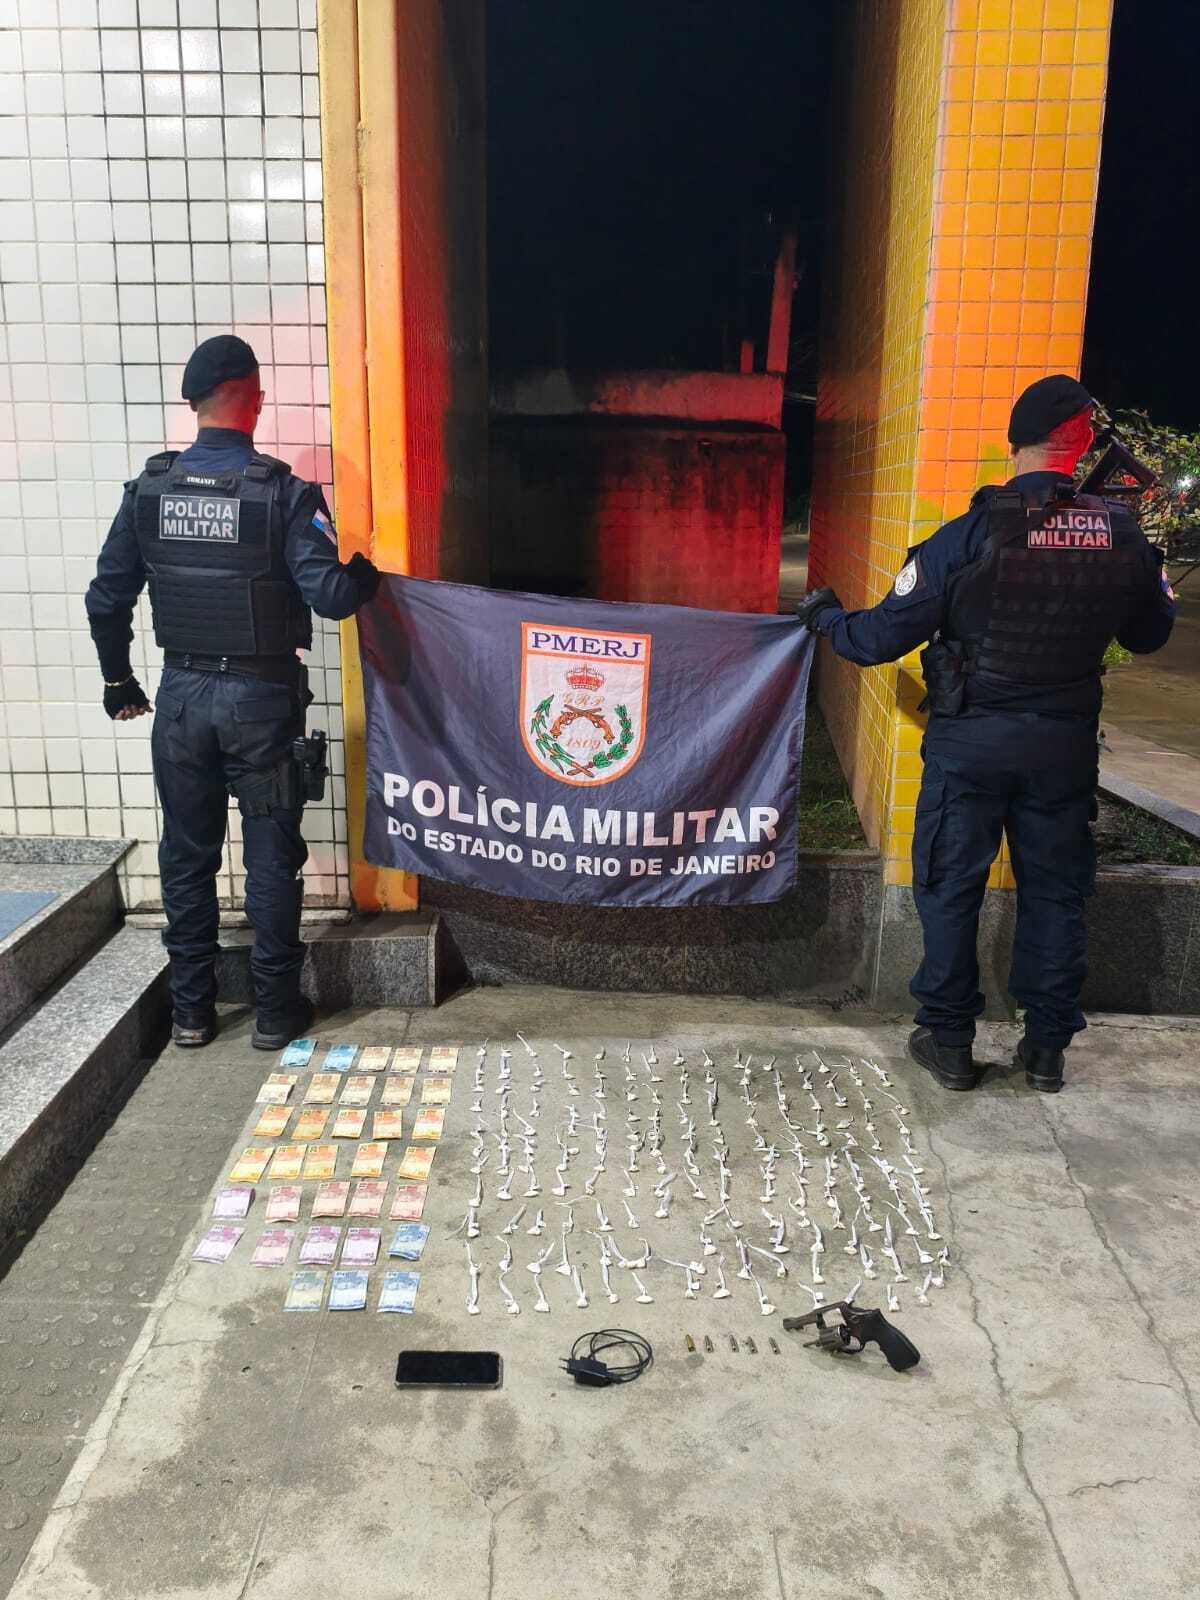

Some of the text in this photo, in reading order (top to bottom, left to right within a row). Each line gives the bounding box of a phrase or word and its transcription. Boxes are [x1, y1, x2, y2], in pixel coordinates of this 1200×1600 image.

[163, 499, 234, 520] POLÍCIA
[163, 518, 234, 538] MILITAR
[1043, 512, 1107, 530] OLÍCIA
[1030, 530, 1109, 546] MILITAR
[531, 631, 643, 658] PMERJ
[383, 772, 780, 847] POLÍCIA MILITAR
[387, 816, 776, 877] DO ESTADO DO RIO DE JANEIRO
